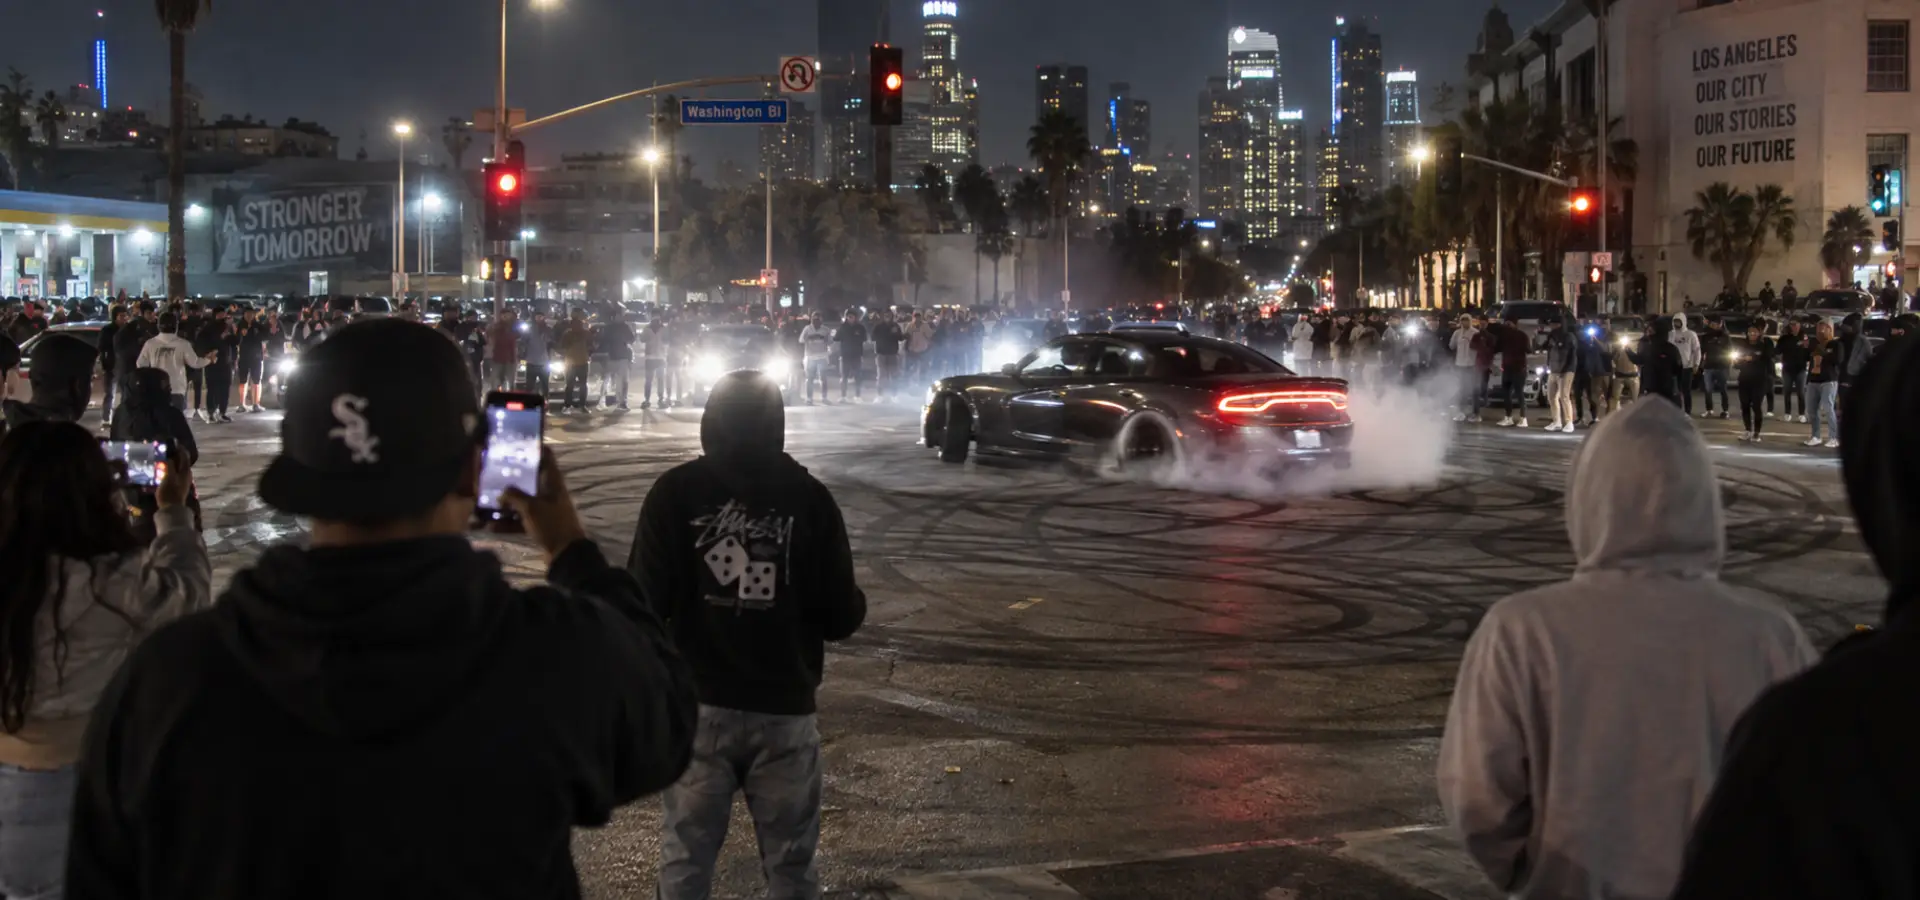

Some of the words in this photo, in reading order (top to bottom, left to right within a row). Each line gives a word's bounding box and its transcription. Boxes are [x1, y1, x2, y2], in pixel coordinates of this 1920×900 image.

[1692, 47, 1720, 72] LOS
[1724, 34, 1797, 67] ANGELES
[1696, 79, 1726, 104] OUR
[1731, 72, 1767, 98] CITY
[687, 105, 762, 120] Washington
[1694, 112, 1724, 136] OUR
[1729, 103, 1796, 132] STORIES
[1696, 145, 1726, 168] OUR
[1731, 138, 1795, 165] FUTURE
[223, 204, 238, 233] A
[244, 190, 363, 231] STRONGER
[240, 223, 372, 263] TOMORROW
